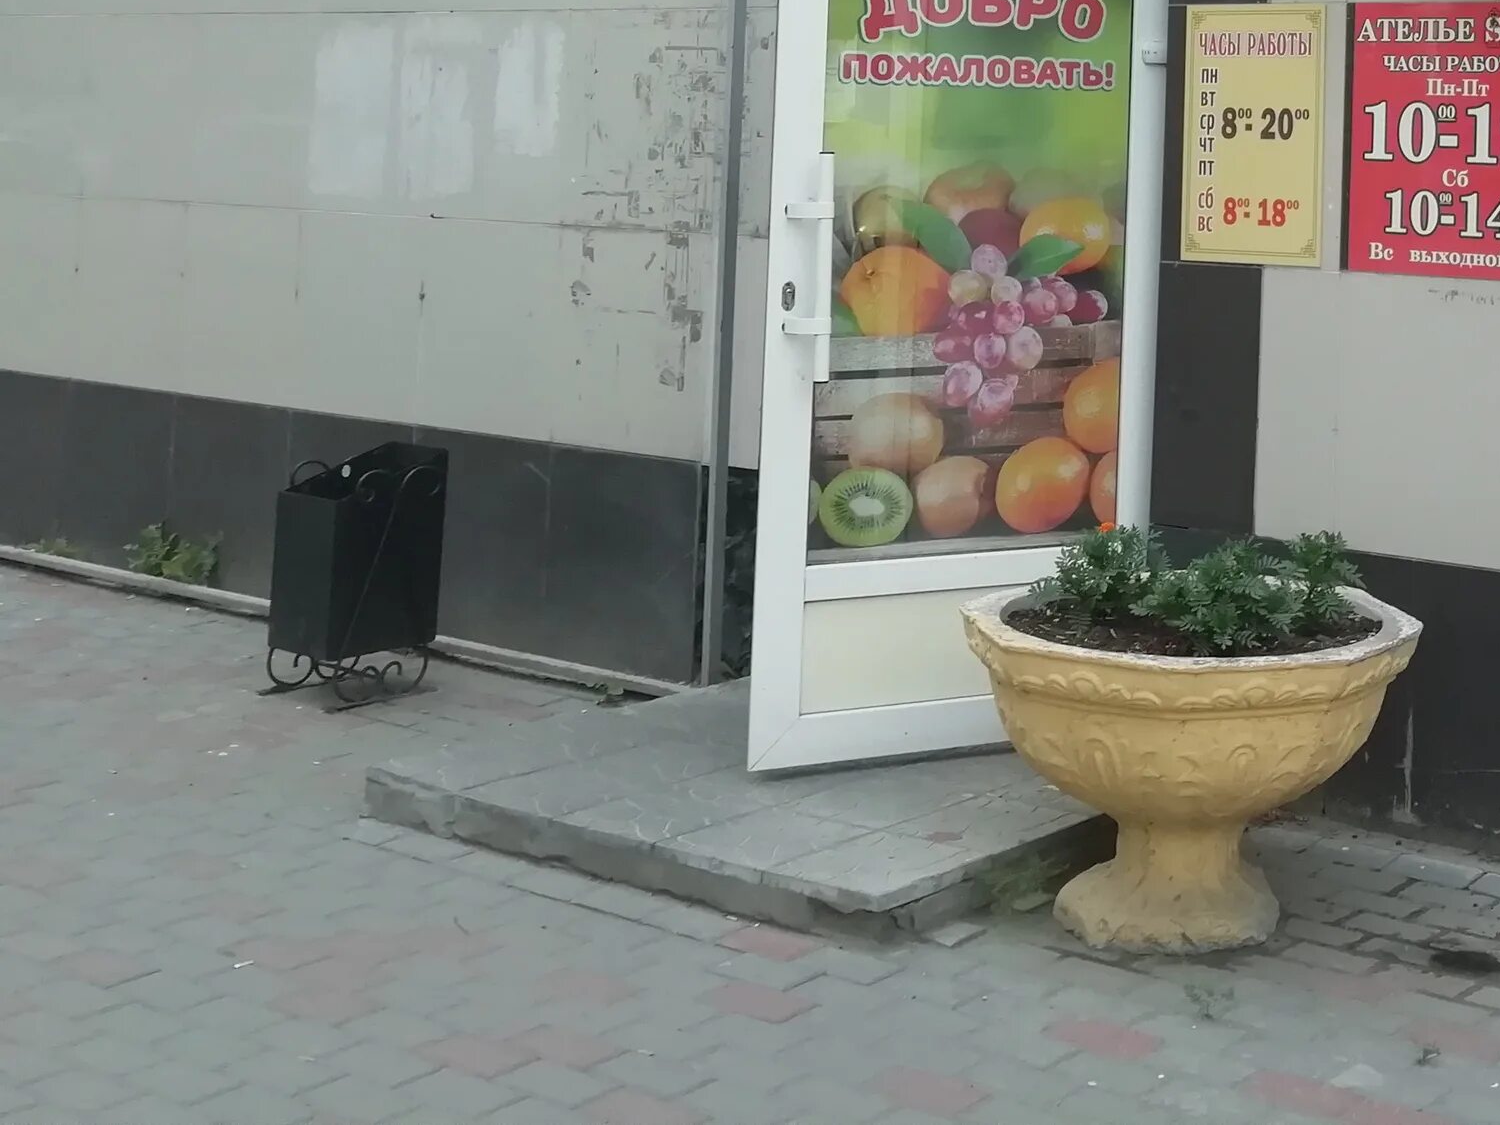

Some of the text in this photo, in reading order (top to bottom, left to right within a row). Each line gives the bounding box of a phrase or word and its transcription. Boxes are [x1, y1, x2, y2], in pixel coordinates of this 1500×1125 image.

[1356, 17, 1475, 43] АТЕЛЬЕ
[1199, 31, 1313, 57] ЧАСЫ РАБОТЫ
[838, 52, 1116, 91] ПОЖАЛОВАТЬ!
[1383, 55, 1441, 73] ЧАСЫ
[1426, 78, 1490, 97] Пн-Пт
[1441, 168, 1470, 188] Сб
[1368, 241, 1394, 262] Вс
